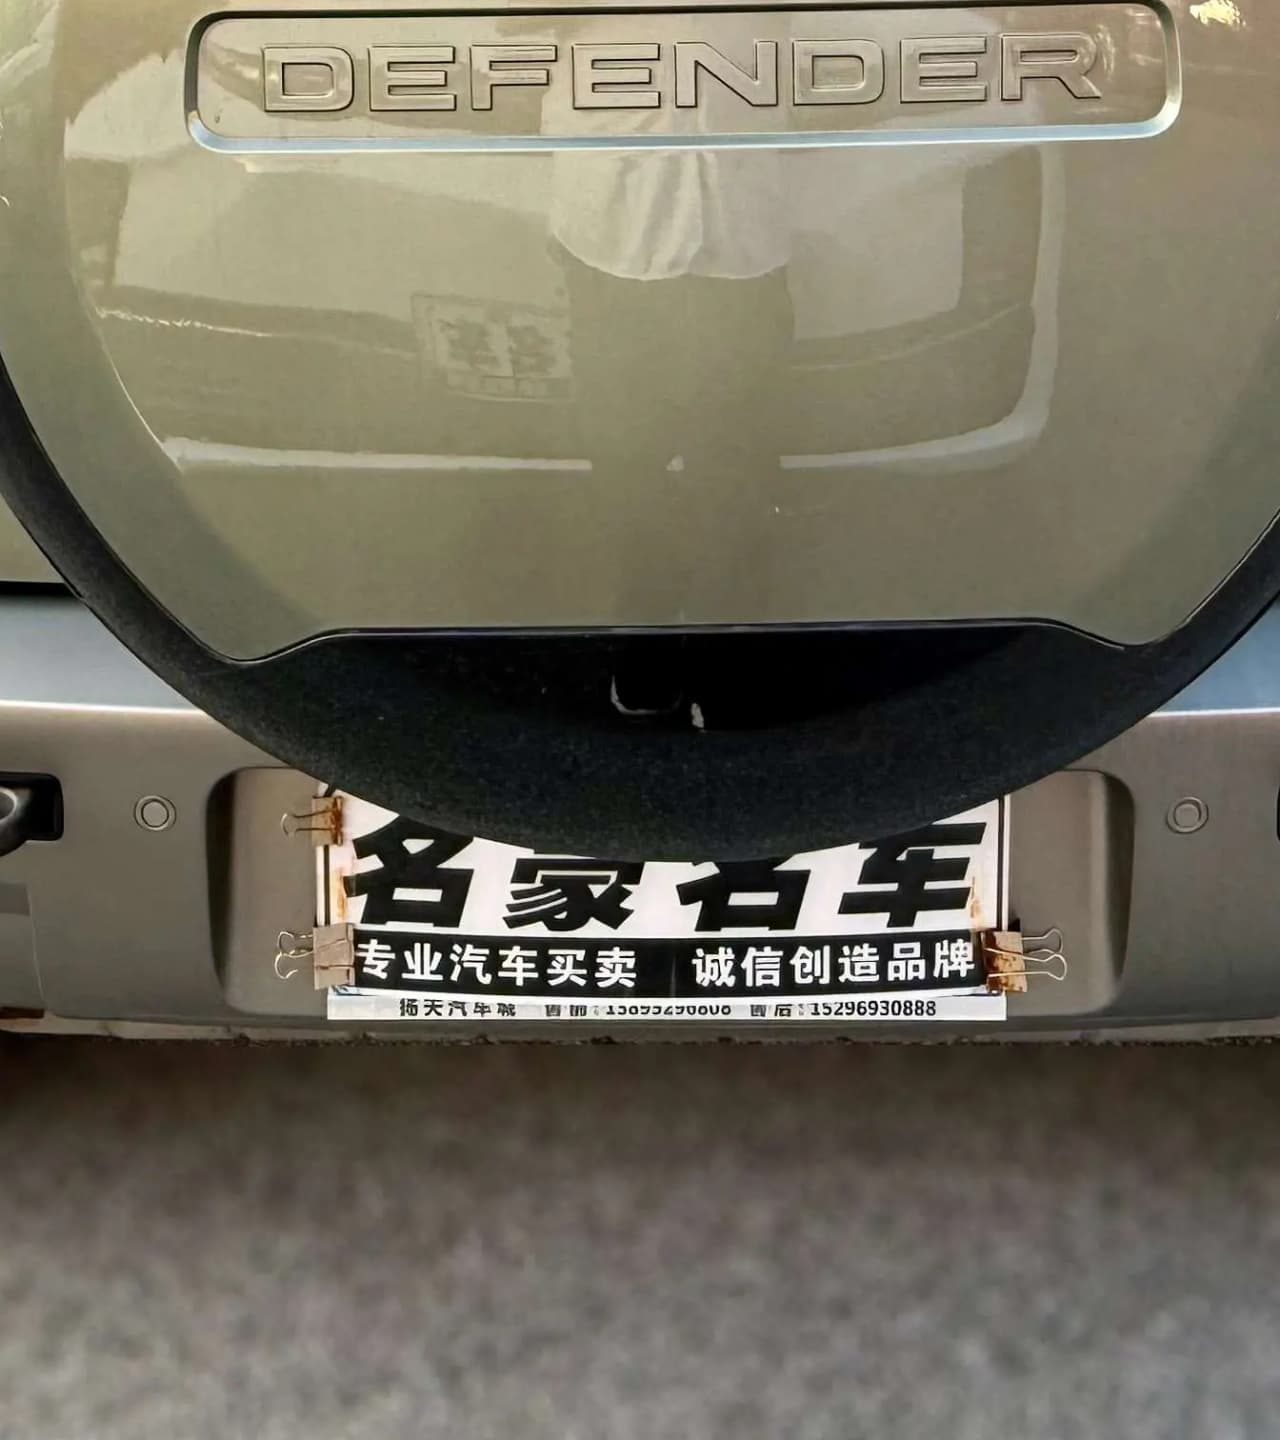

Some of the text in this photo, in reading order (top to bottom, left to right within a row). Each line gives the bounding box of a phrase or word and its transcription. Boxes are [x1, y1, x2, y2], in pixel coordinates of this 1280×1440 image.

[260, 31, 1102, 114] DEFENDER
[355, 938, 977, 989] 专业汽车买卖 诚信创造品牌
